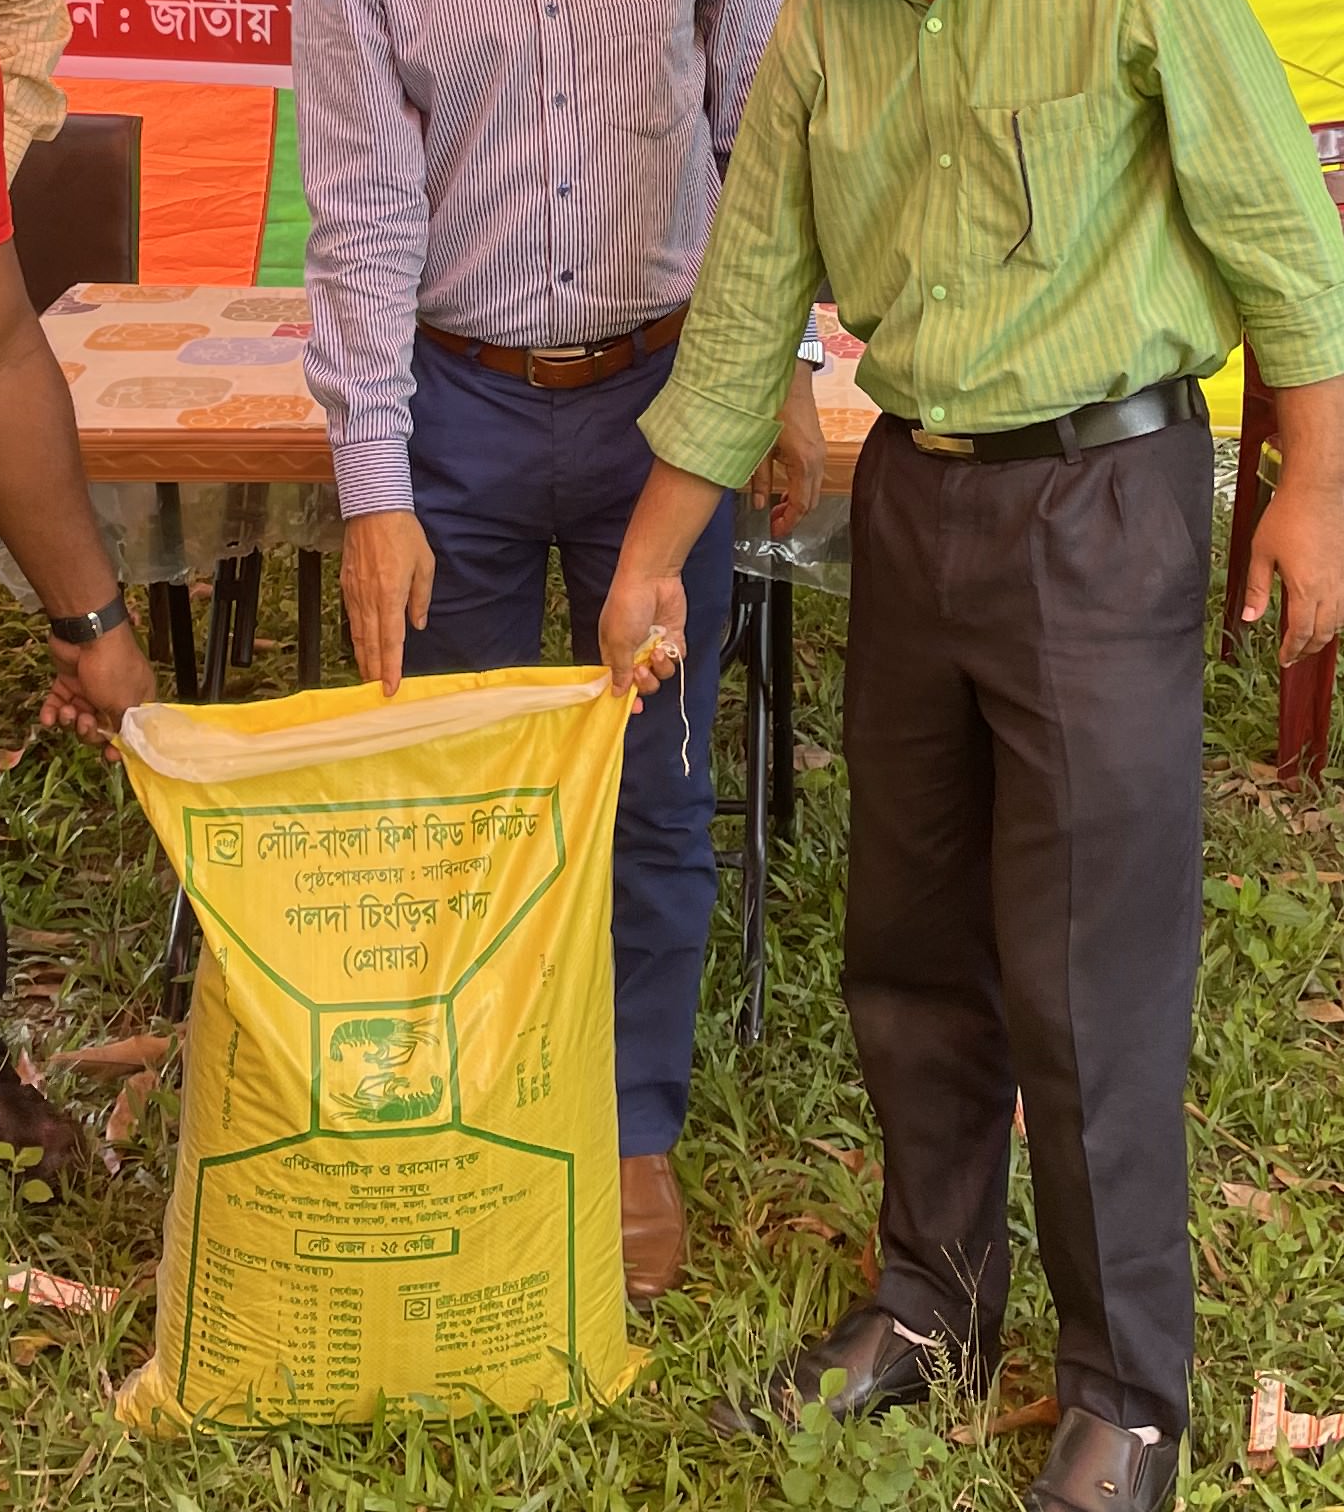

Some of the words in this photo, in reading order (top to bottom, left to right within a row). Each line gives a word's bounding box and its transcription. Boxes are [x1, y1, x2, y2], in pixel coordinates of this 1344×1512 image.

[257, 820, 370, 861] সৌদি-বাংলা
[375, 815, 418, 855] ফিশ
[422, 813, 466, 852] ফিড
[469, 804, 541, 845] লিমিটেড
[284, 901, 351, 936] গলদা
[357, 891, 440, 934] চিংড়ির
[447, 889, 493, 923] খাদ্য
[342, 940, 429, 978] (গ্রোয়ার)
[378, 1165, 391, 1177] ও
[396, 1158, 449, 1178] হরমোন
[307, 1235, 330, 1254] নেট
[335, 1239, 365, 1257] ওজন
[380, 1238, 399, 1255] ২৫
[404, 1235, 436, 1253] কেজি
